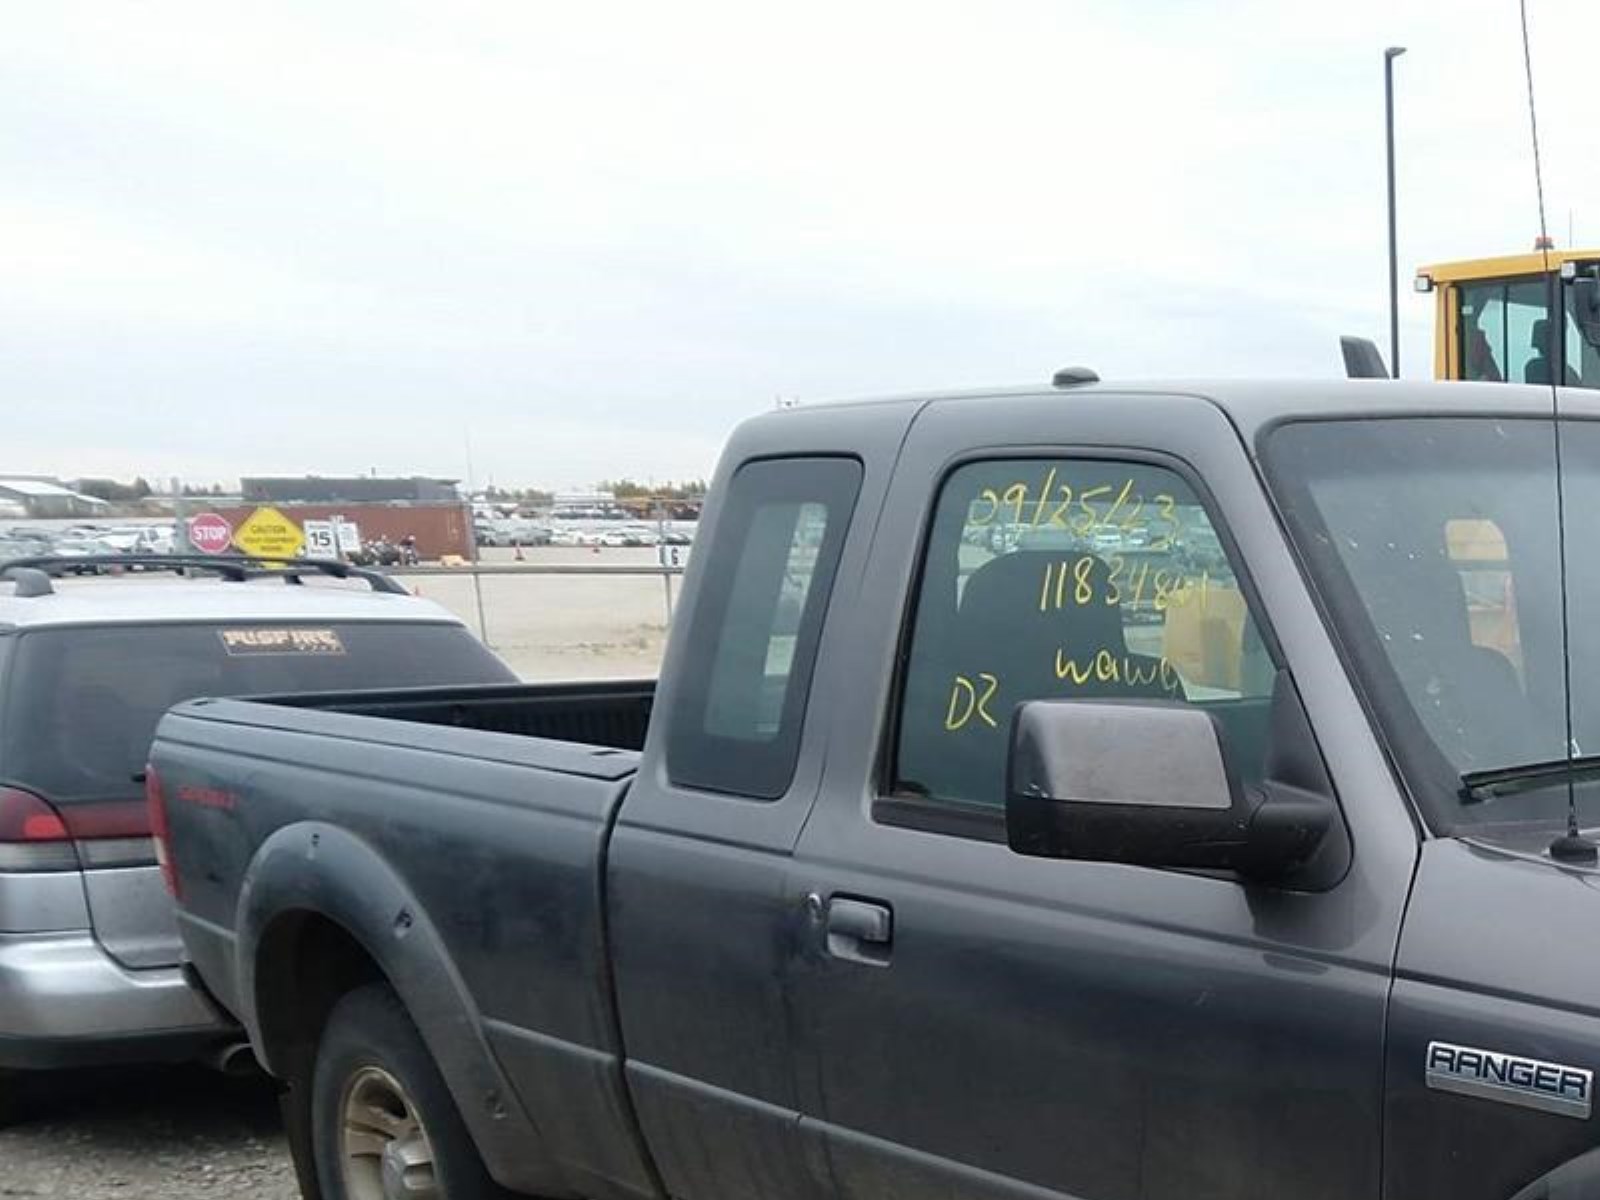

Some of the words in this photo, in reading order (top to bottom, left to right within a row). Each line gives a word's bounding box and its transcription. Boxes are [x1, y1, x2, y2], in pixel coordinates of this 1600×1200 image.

[193, 526, 227, 541] STOP
[310, 531, 330, 547] 15
[1429, 1046, 1589, 1099] RANGER
